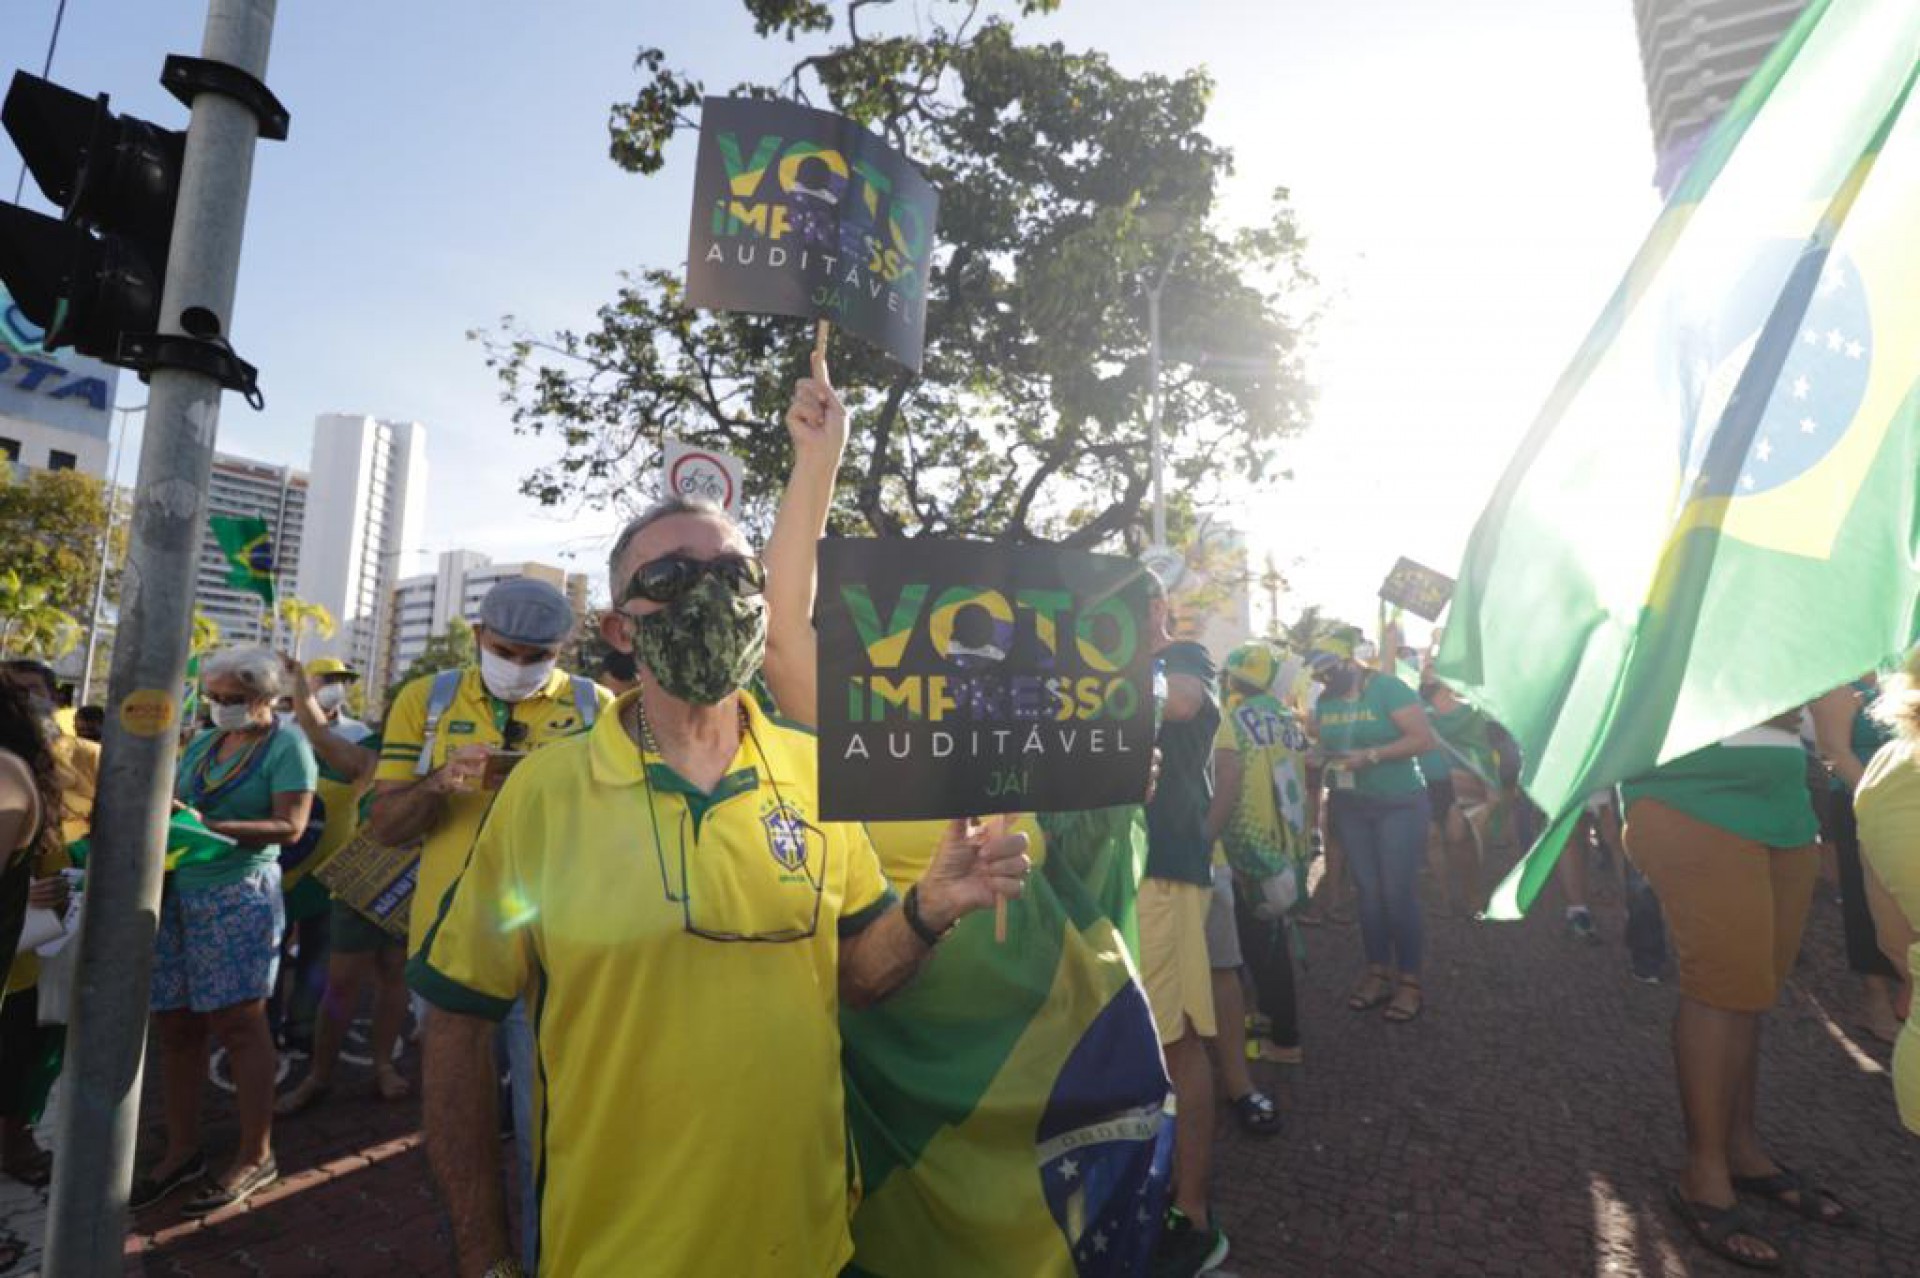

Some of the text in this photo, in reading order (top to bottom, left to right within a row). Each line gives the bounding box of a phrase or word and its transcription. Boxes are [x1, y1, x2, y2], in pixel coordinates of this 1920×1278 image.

[717, 132, 924, 262] VOTO
[705, 242, 911, 324] AUDITÁVEL
[711, 199, 918, 300] IMPRESSO
[0, 351, 106, 412] TA
[840, 585, 1137, 672] VOTO
[849, 675, 1139, 721] IMPRESSO
[844, 724, 1131, 760] AUDITÁVEL
